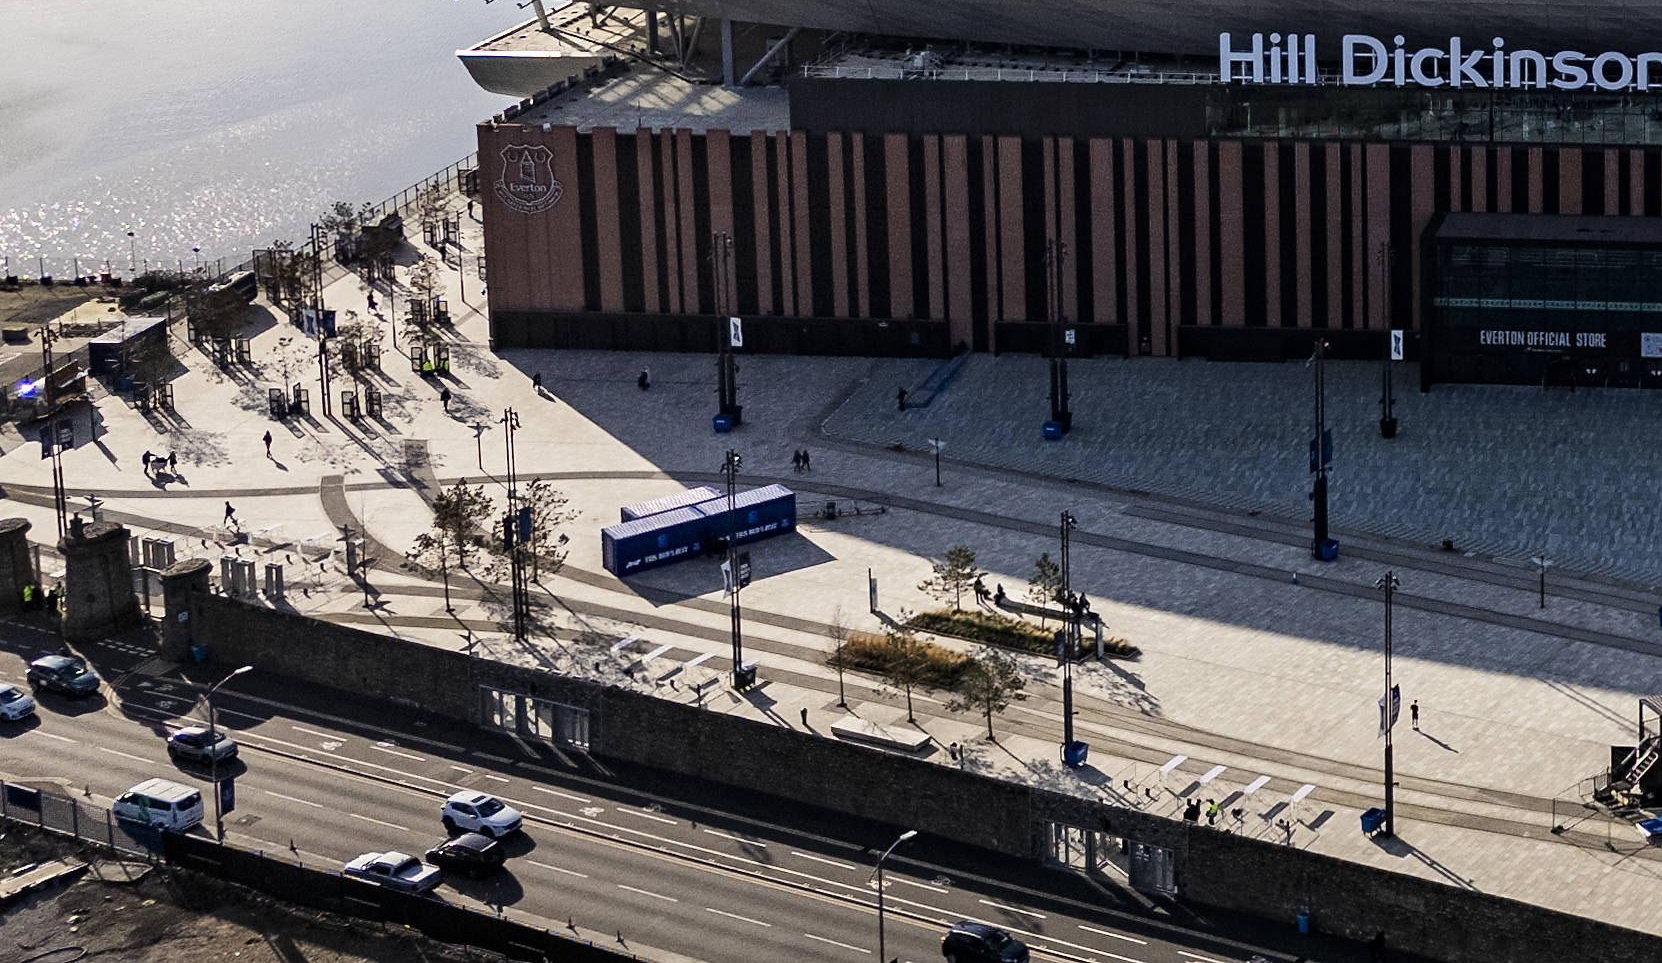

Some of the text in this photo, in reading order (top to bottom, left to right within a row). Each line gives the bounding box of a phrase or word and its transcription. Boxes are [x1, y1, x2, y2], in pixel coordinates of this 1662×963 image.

[1219, 32, 1316, 84] Hill
[510, 182, 547, 192] Everton
[1480, 330, 1607, 348] EVERTON OFFICIAL STORE
